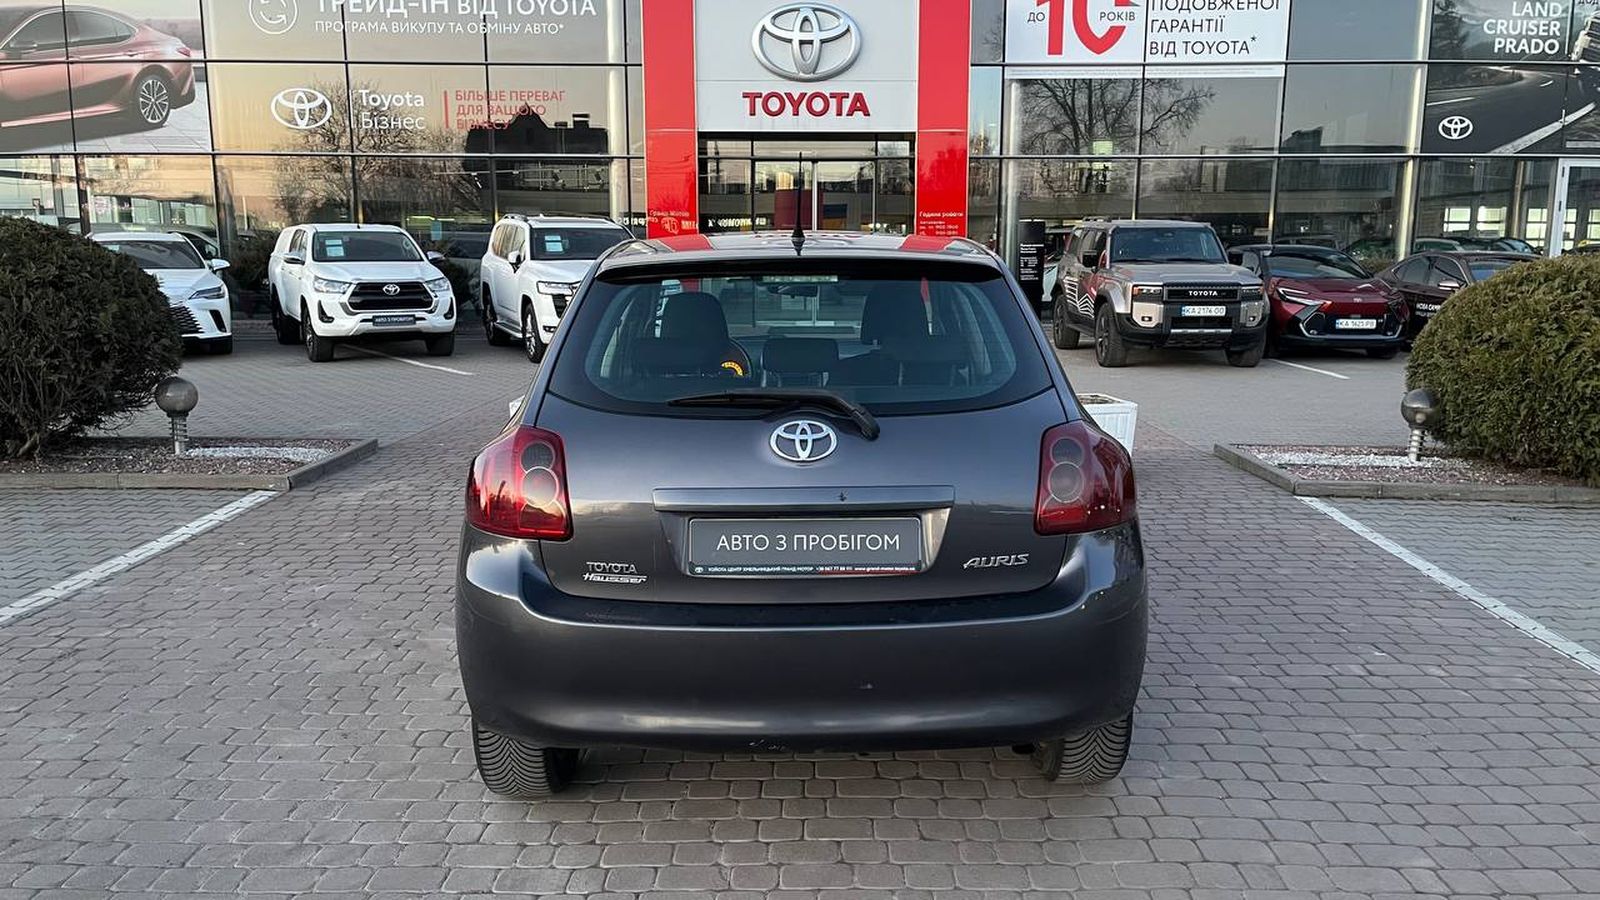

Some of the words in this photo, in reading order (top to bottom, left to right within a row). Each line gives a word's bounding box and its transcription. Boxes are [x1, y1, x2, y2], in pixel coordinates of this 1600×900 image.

[457, 0, 498, 18] ВІД
[1027, 12, 1046, 23] ДО
[1099, 11, 1136, 22] РОКІВ
[1511, 1, 1562, 17] LAND
[315, 20, 389, 33] ПРОГРАМА
[391, 22, 446, 34] ВИКУПУ
[447, 22, 464, 34] ТА
[466, 22, 521, 34] ОБМІНУ
[1150, 15, 1226, 34] ГАРАНТІЇ
[1483, 19, 1561, 36] CRUISER
[1149, 41, 1177, 58] ВІД
[1493, 38, 1560, 55] PRADO
[358, 89, 424, 110] Toyota
[455, 90, 507, 101] БІЛЬШЕ
[509, 90, 566, 101] ПЕРЕВАГ
[742, 91, 871, 117] TOYOTA
[456, 104, 484, 116] ДЛЯ
[361, 111, 425, 130] Бізнес
[715, 533, 770, 551] АВТО
[793, 532, 901, 551] ПРОБІГОМ
[586, 561, 638, 574] TOYOTA
[963, 553, 1029, 569] AURIS
